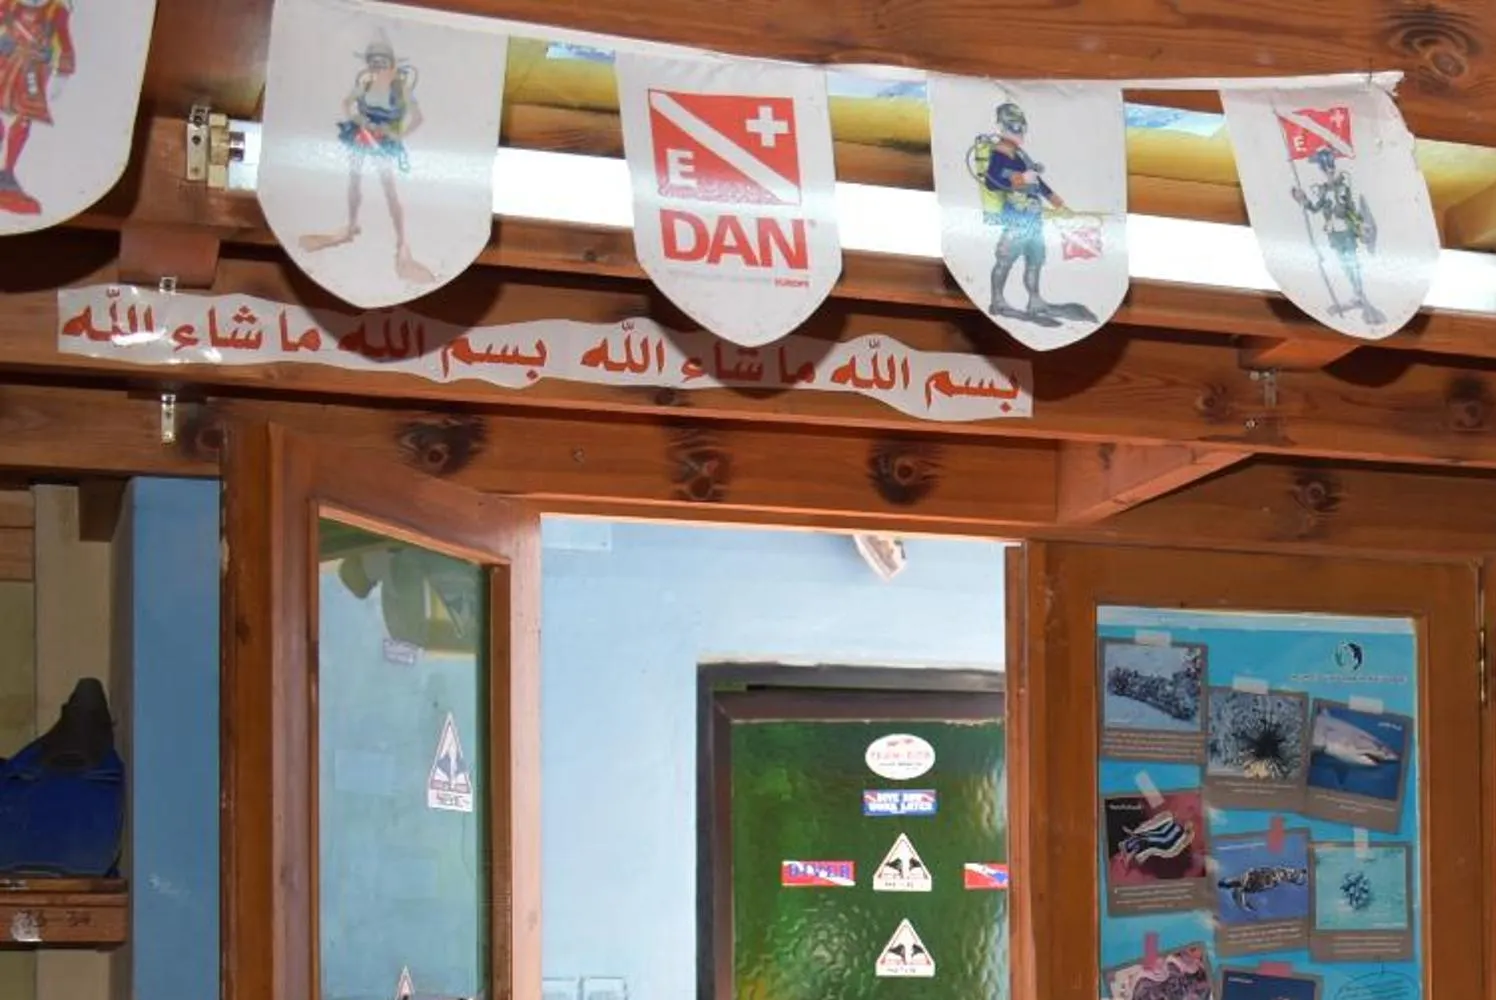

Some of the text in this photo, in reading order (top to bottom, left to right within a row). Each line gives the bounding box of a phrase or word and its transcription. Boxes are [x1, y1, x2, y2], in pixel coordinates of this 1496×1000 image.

[666, 147, 698, 188] E
[660, 208, 809, 270] DAN
[440, 336, 548, 380] بسم
[925, 370, 1021, 413] بسم
